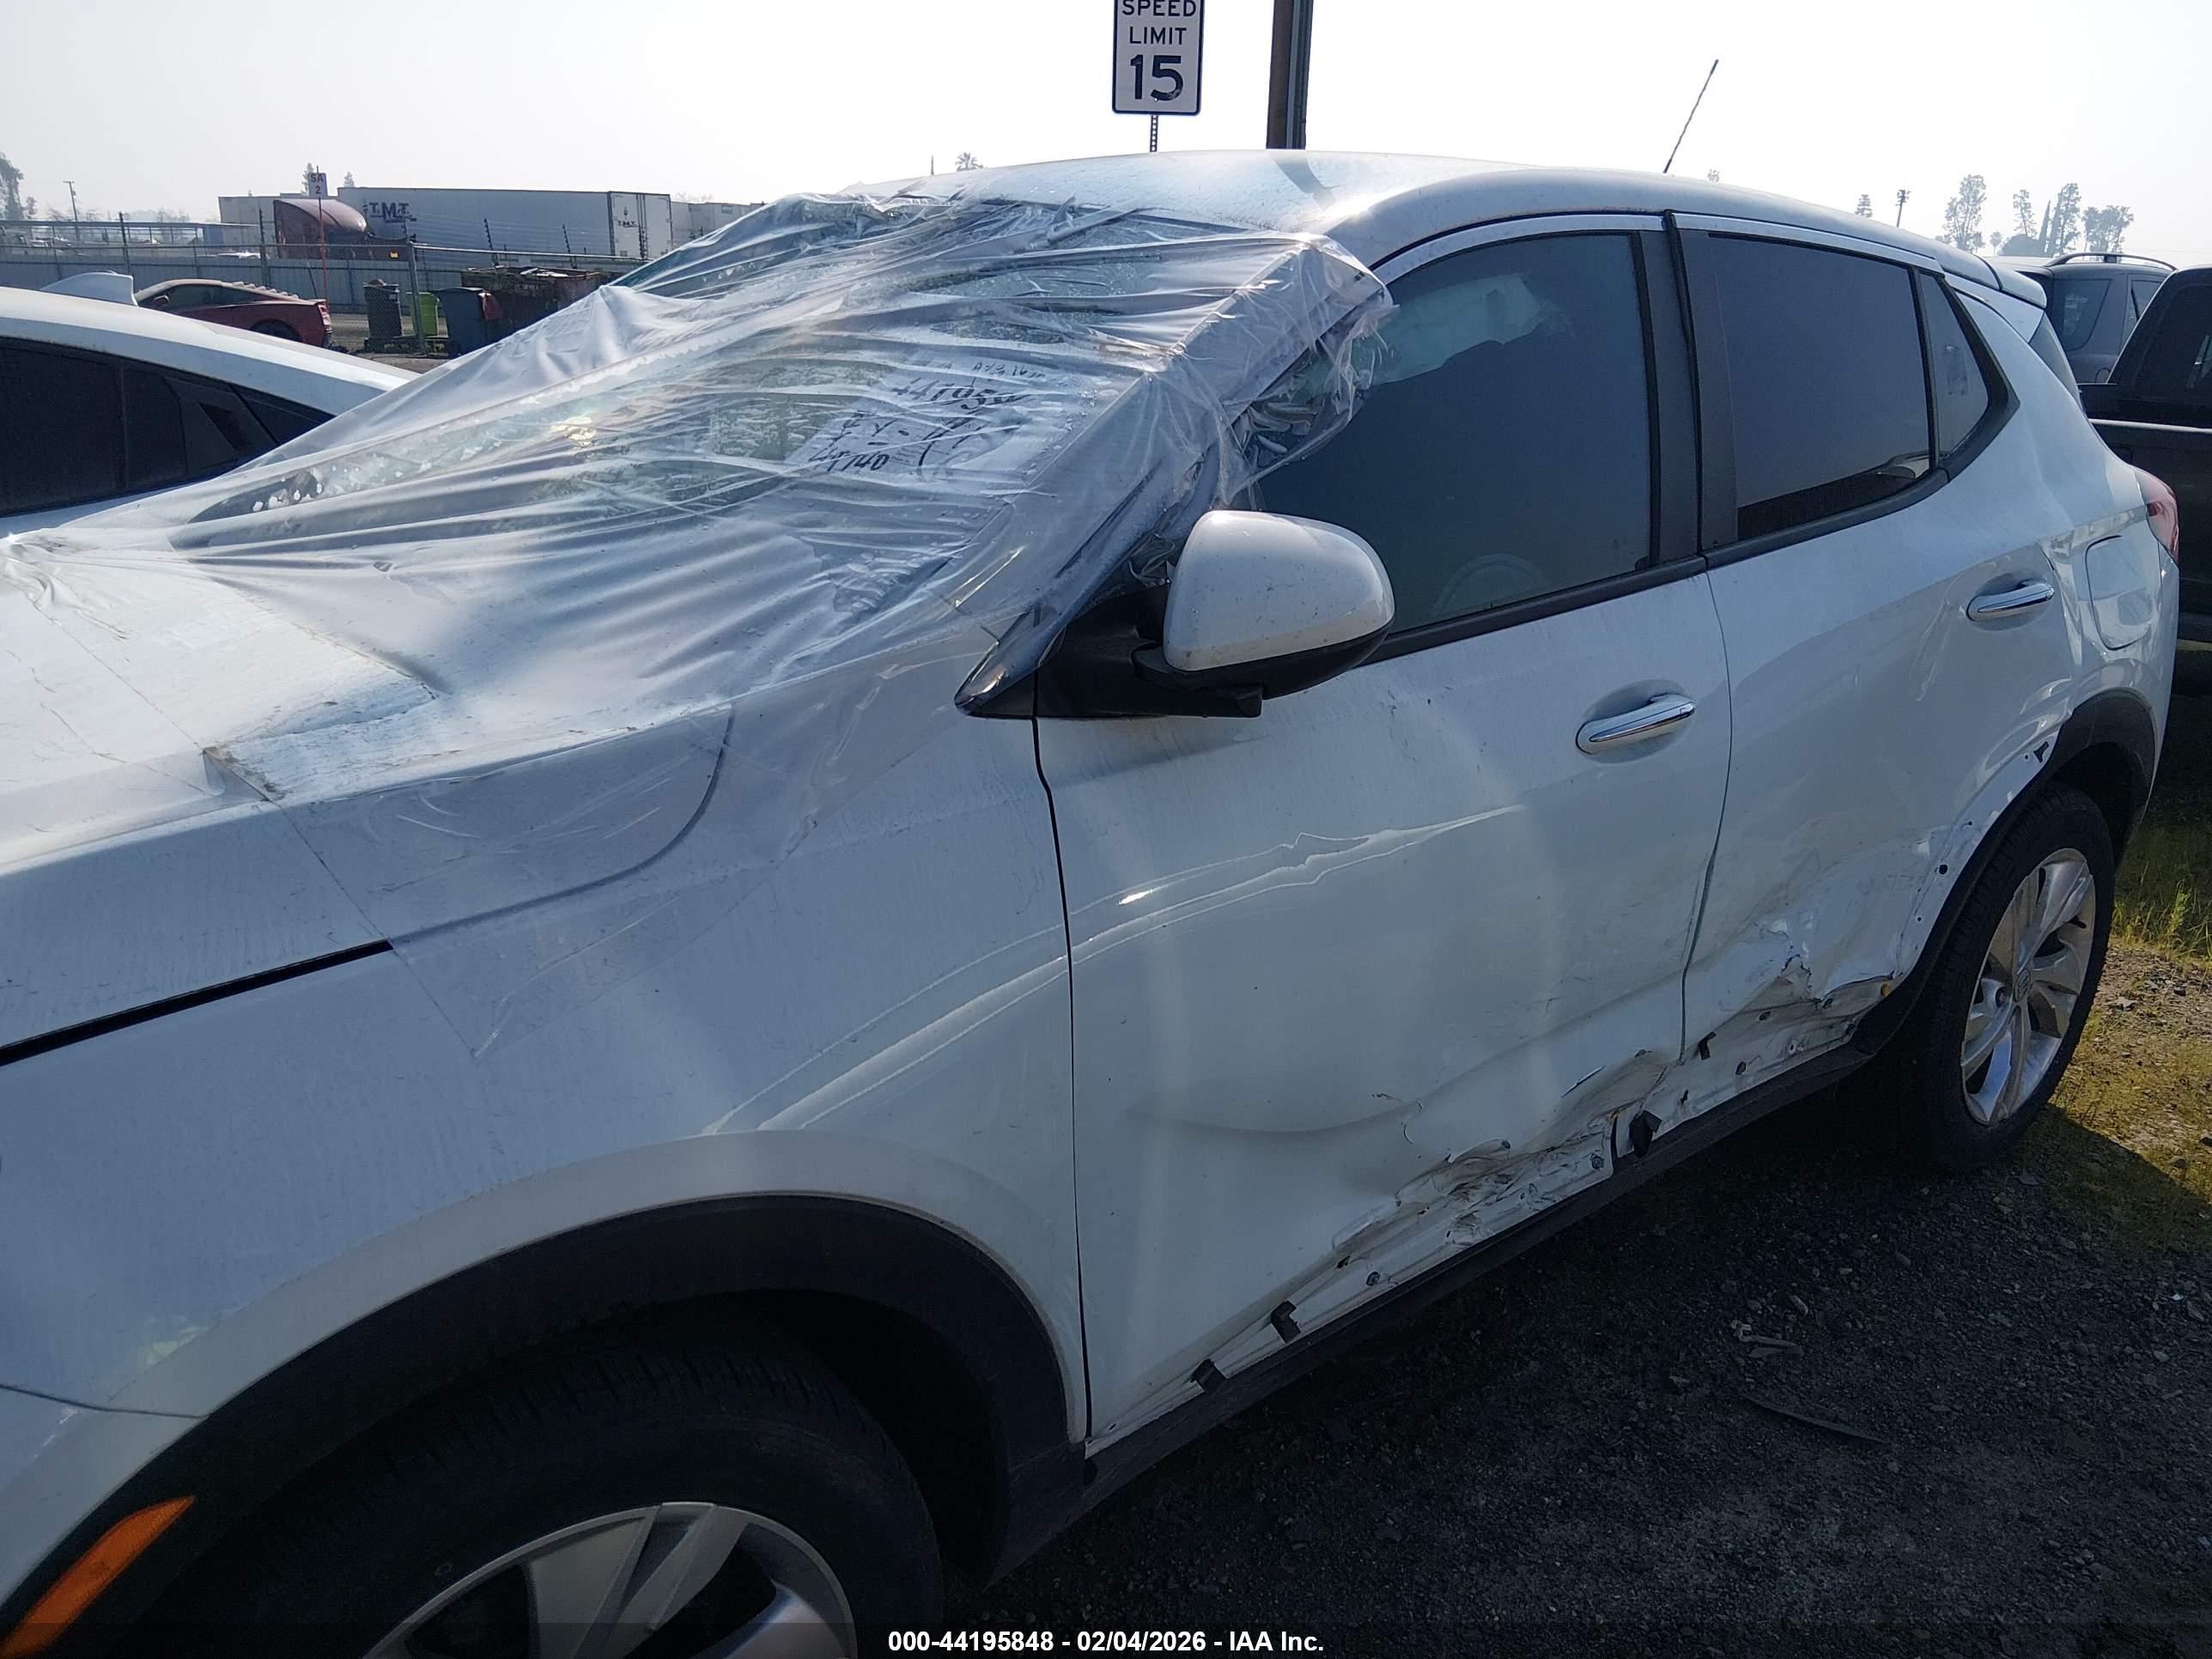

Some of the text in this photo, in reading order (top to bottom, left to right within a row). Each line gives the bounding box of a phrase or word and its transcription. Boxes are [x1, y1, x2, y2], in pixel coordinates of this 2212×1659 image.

[1121, 0, 1197, 17] SPEED
[1129, 27, 1188, 46] LIMIT
[1130, 54, 1183, 101] 15
[310, 173, 324, 183] SA
[315, 185, 321, 194] 2
